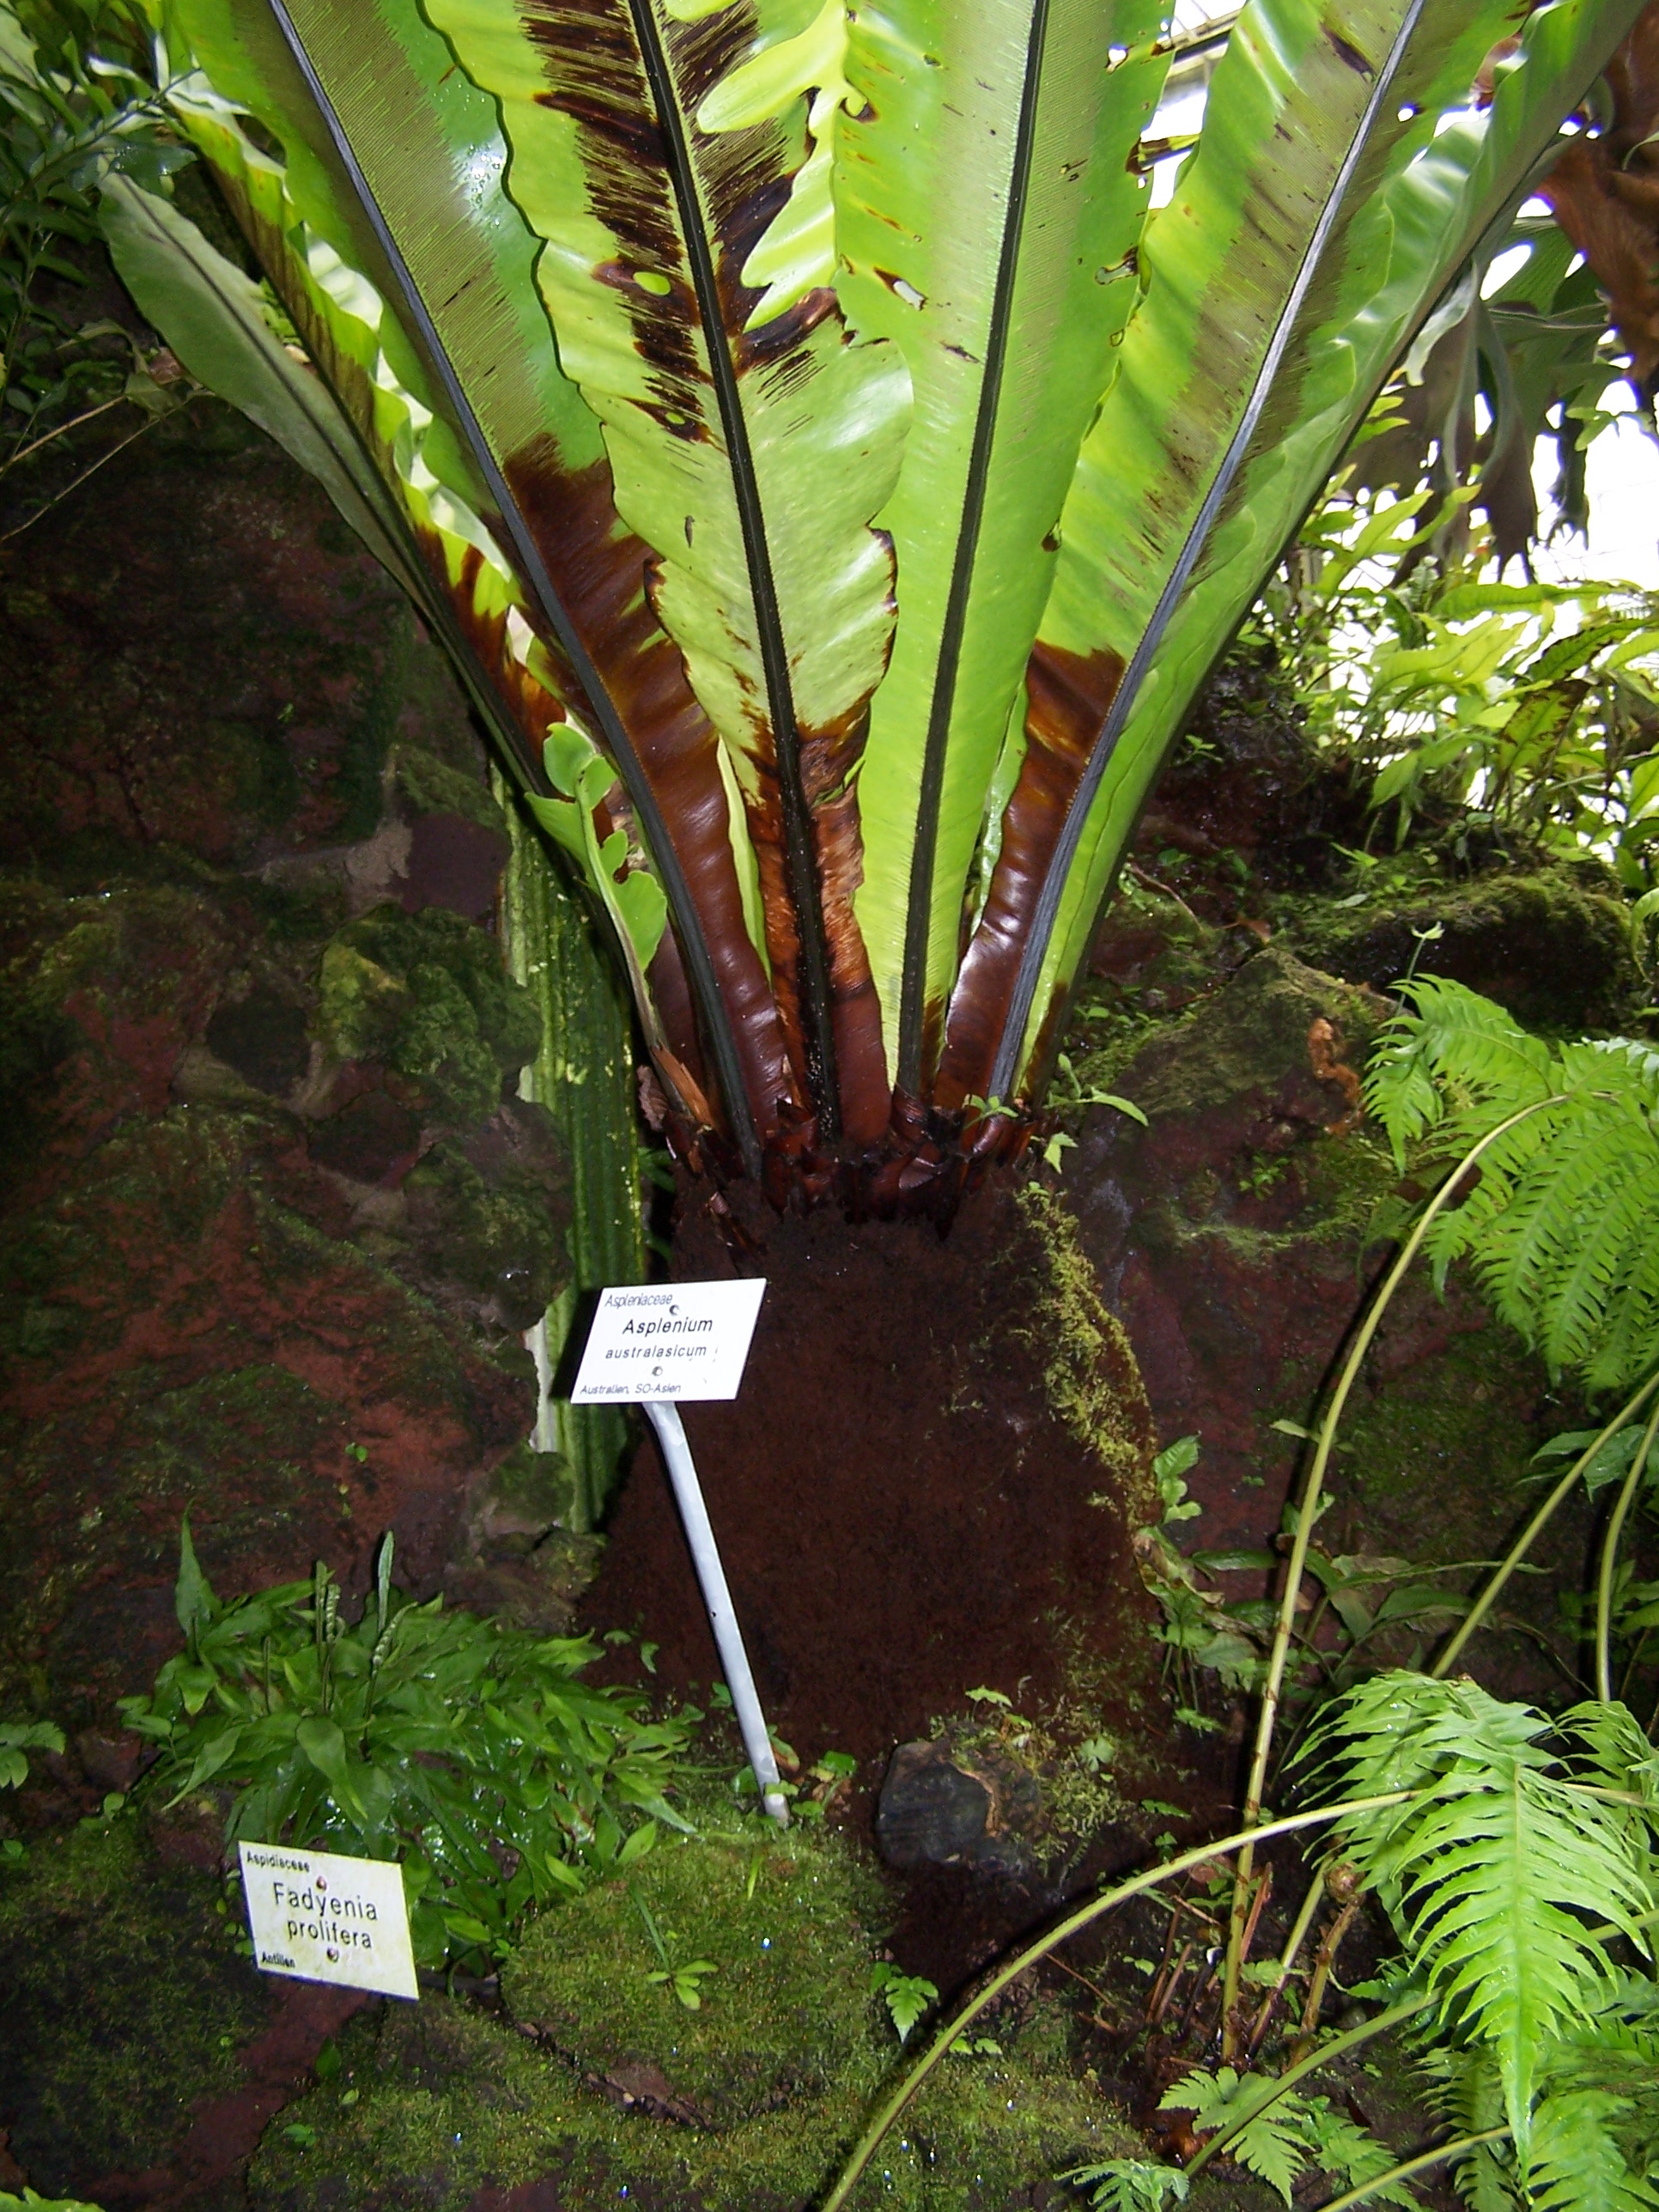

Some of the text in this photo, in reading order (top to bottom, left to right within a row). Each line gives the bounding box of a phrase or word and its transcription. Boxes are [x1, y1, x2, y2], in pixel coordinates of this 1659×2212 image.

[605, 1293, 672, 1309] Aspleniaceae
[622, 1316, 713, 1337] Asplenium
[605, 1344, 707, 1358] australasicum
[273, 1881, 378, 1920] Fadyenia
[288, 1919, 372, 1948] prolifera
